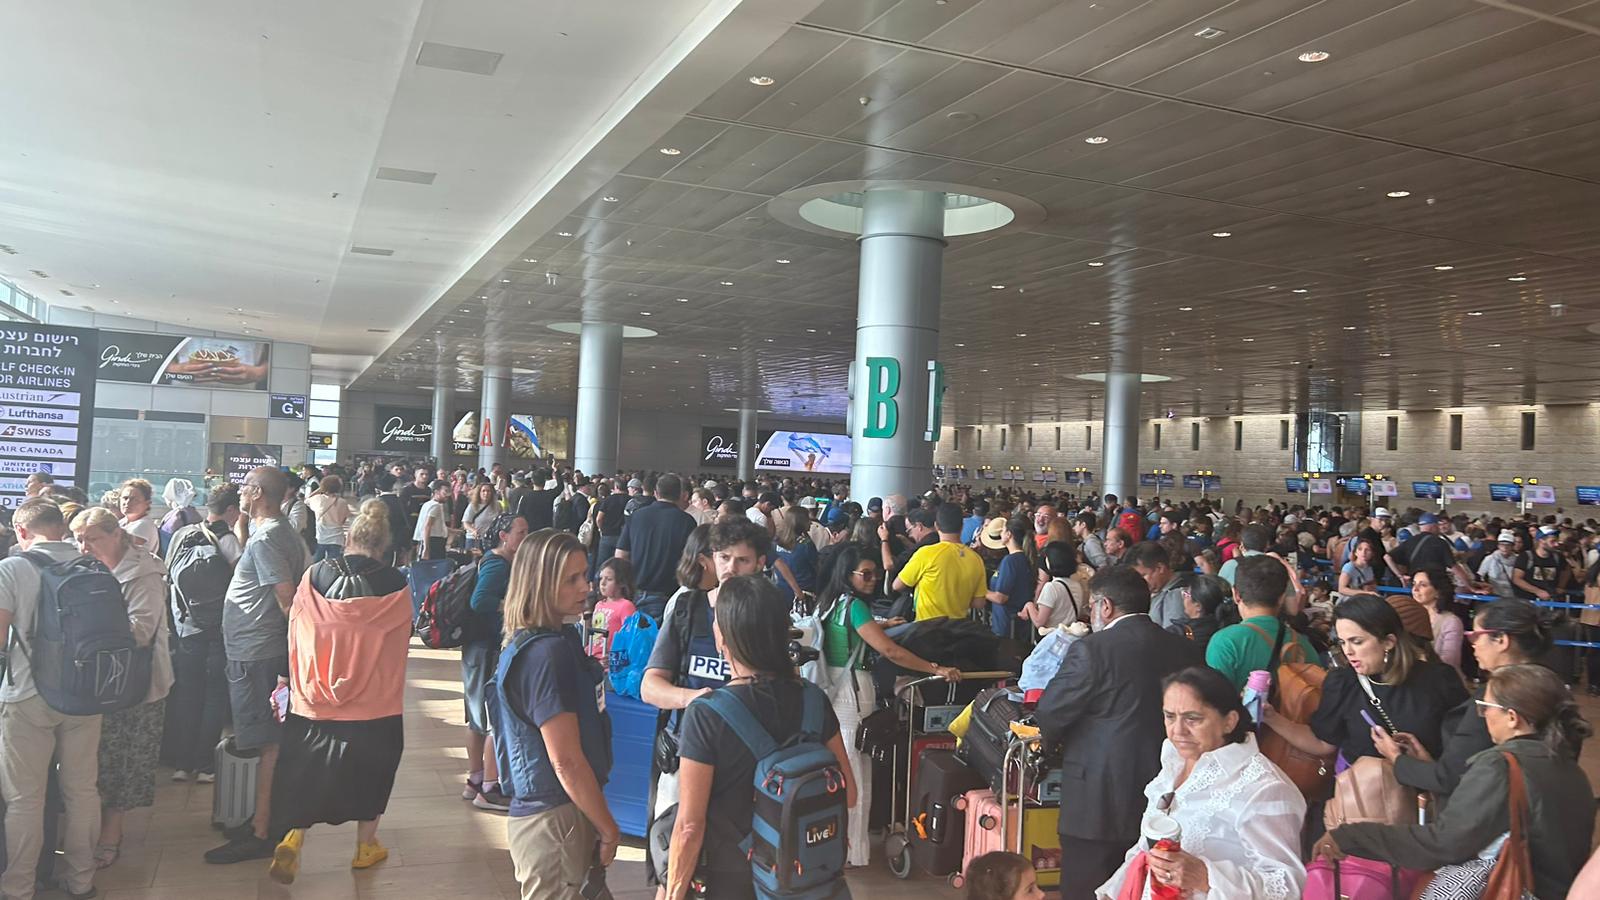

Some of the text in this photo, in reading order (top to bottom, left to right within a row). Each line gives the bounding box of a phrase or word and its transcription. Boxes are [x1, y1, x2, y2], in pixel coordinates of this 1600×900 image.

[34, 333, 79, 345] רישום
[3, 344, 62, 358] לחברות
[0, 362, 76, 376] LF CHECK-IN
[16, 375, 71, 388] AIRLINES
[0, 391, 44, 402] ustrian
[863, 357, 901, 438] B
[8, 408, 64, 420] Lufthansa
[281, 402, 294, 414] G
[17, 427, 52, 437] SWISS
[480, 418, 493, 446] A
[20, 446, 63, 455] CANADA
[3, 497, 23, 507] DE
[693, 656, 731, 676] PRE
[806, 822, 836, 844] LiveU
